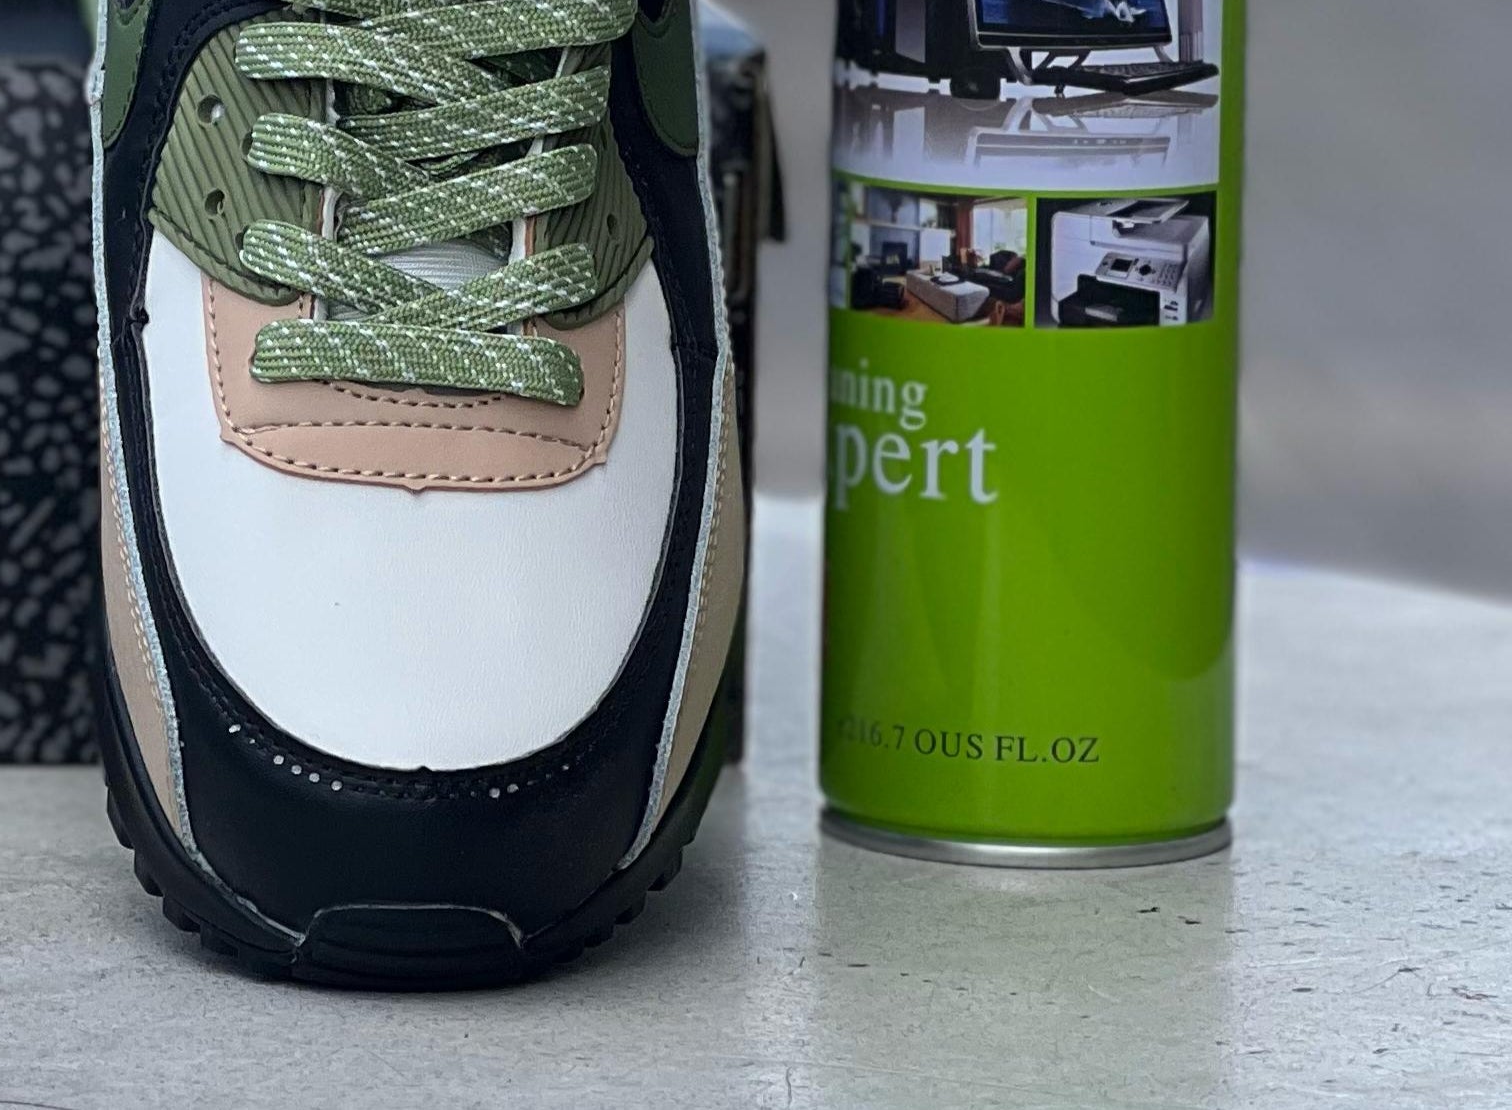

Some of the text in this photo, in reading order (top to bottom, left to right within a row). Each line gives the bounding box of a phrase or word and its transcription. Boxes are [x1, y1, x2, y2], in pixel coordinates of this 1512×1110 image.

[835, 427, 1000, 512] pert
[914, 729, 984, 761] OUS
[995, 735, 1101, 764] FL.OZ
